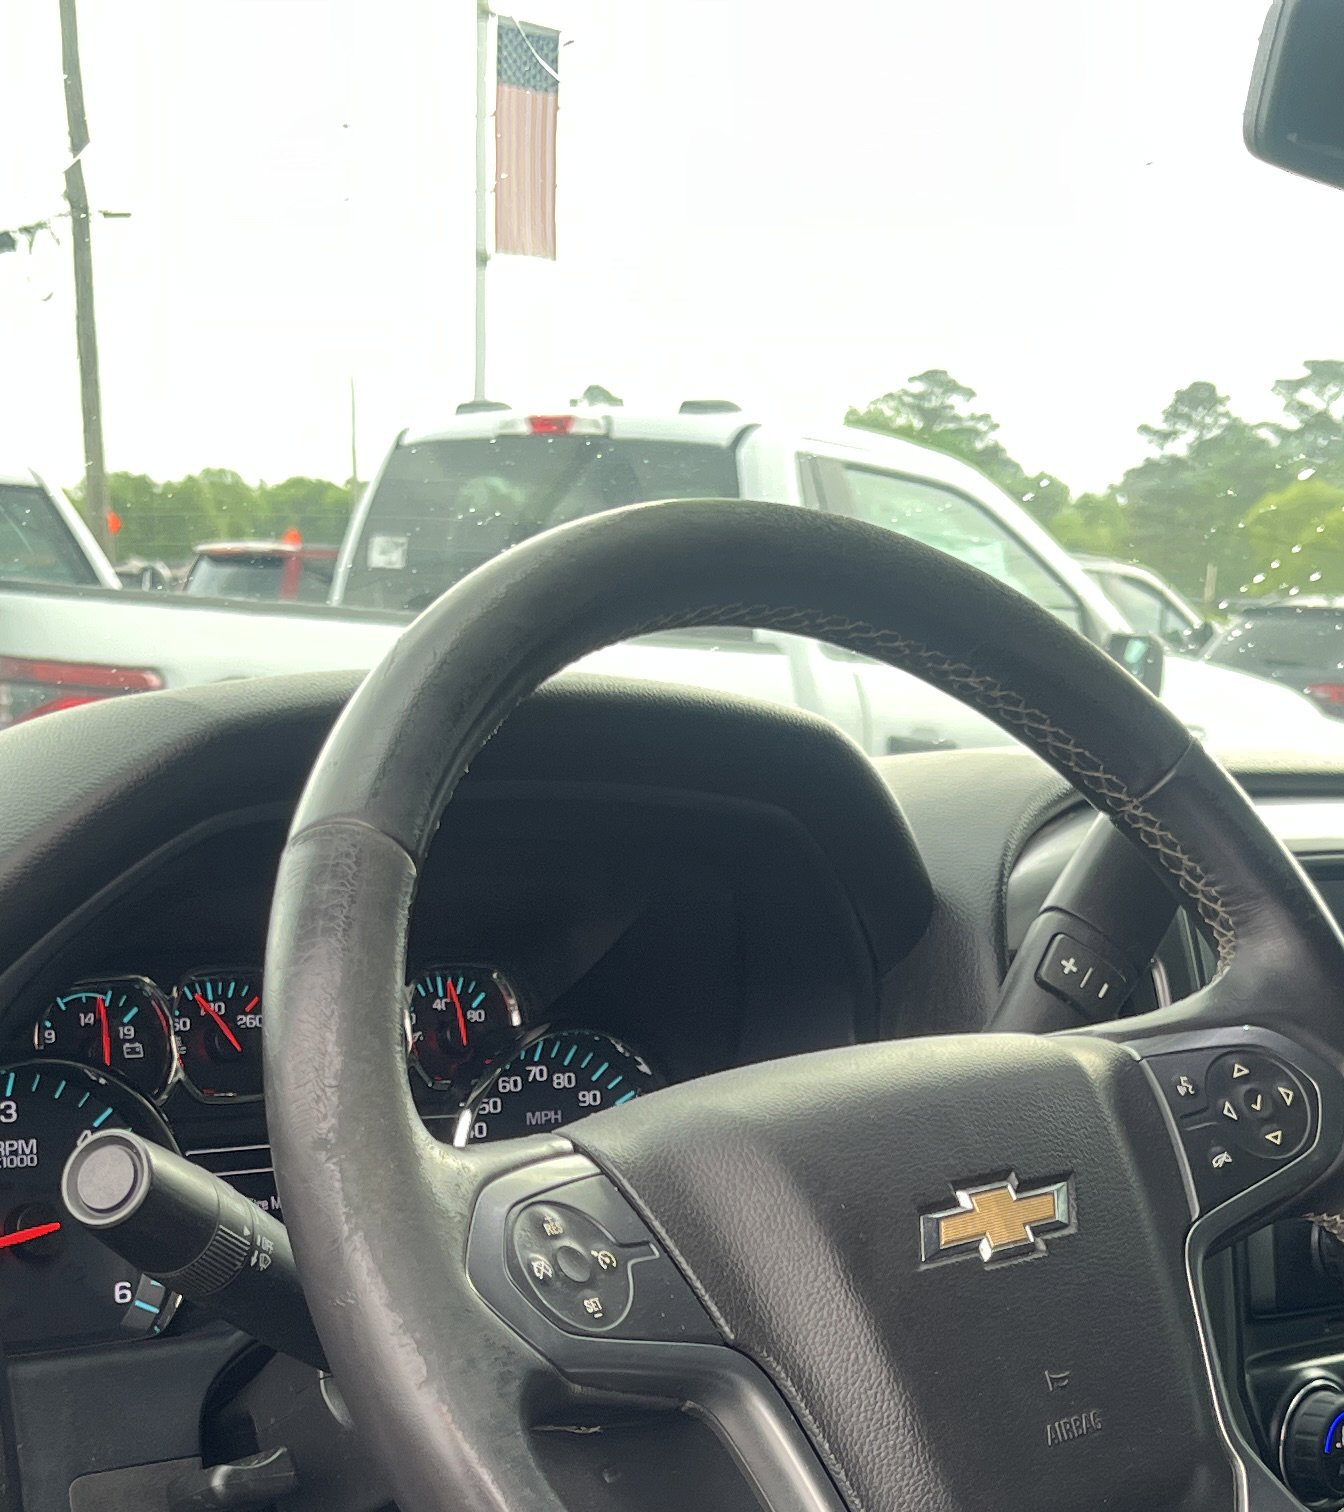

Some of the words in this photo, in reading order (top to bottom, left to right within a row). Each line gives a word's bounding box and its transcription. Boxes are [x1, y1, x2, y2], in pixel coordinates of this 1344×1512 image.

[79, 1012, 94, 1027] 14
[236, 1014, 263, 1029] 260
[467, 1009, 485, 1023] 80
[44, 1028, 56, 1044] 9
[118, 1026, 135, 1039] 19
[526, 1065, 548, 1082] 70
[552, 1072, 576, 1089] 80
[498, 1076, 523, 1093] 60
[478, 1097, 502, 1115] 50
[578, 1091, 601, 1107] 90
[0, 1100, 18, 1123] 3
[525, 1110, 563, 1126] MPH
[469, 1121, 487, 1139] 0
[114, 1281, 132, 1303] 6
[583, 1297, 603, 1314] SET
[1046, 1409, 1102, 1447] AIRBAG
